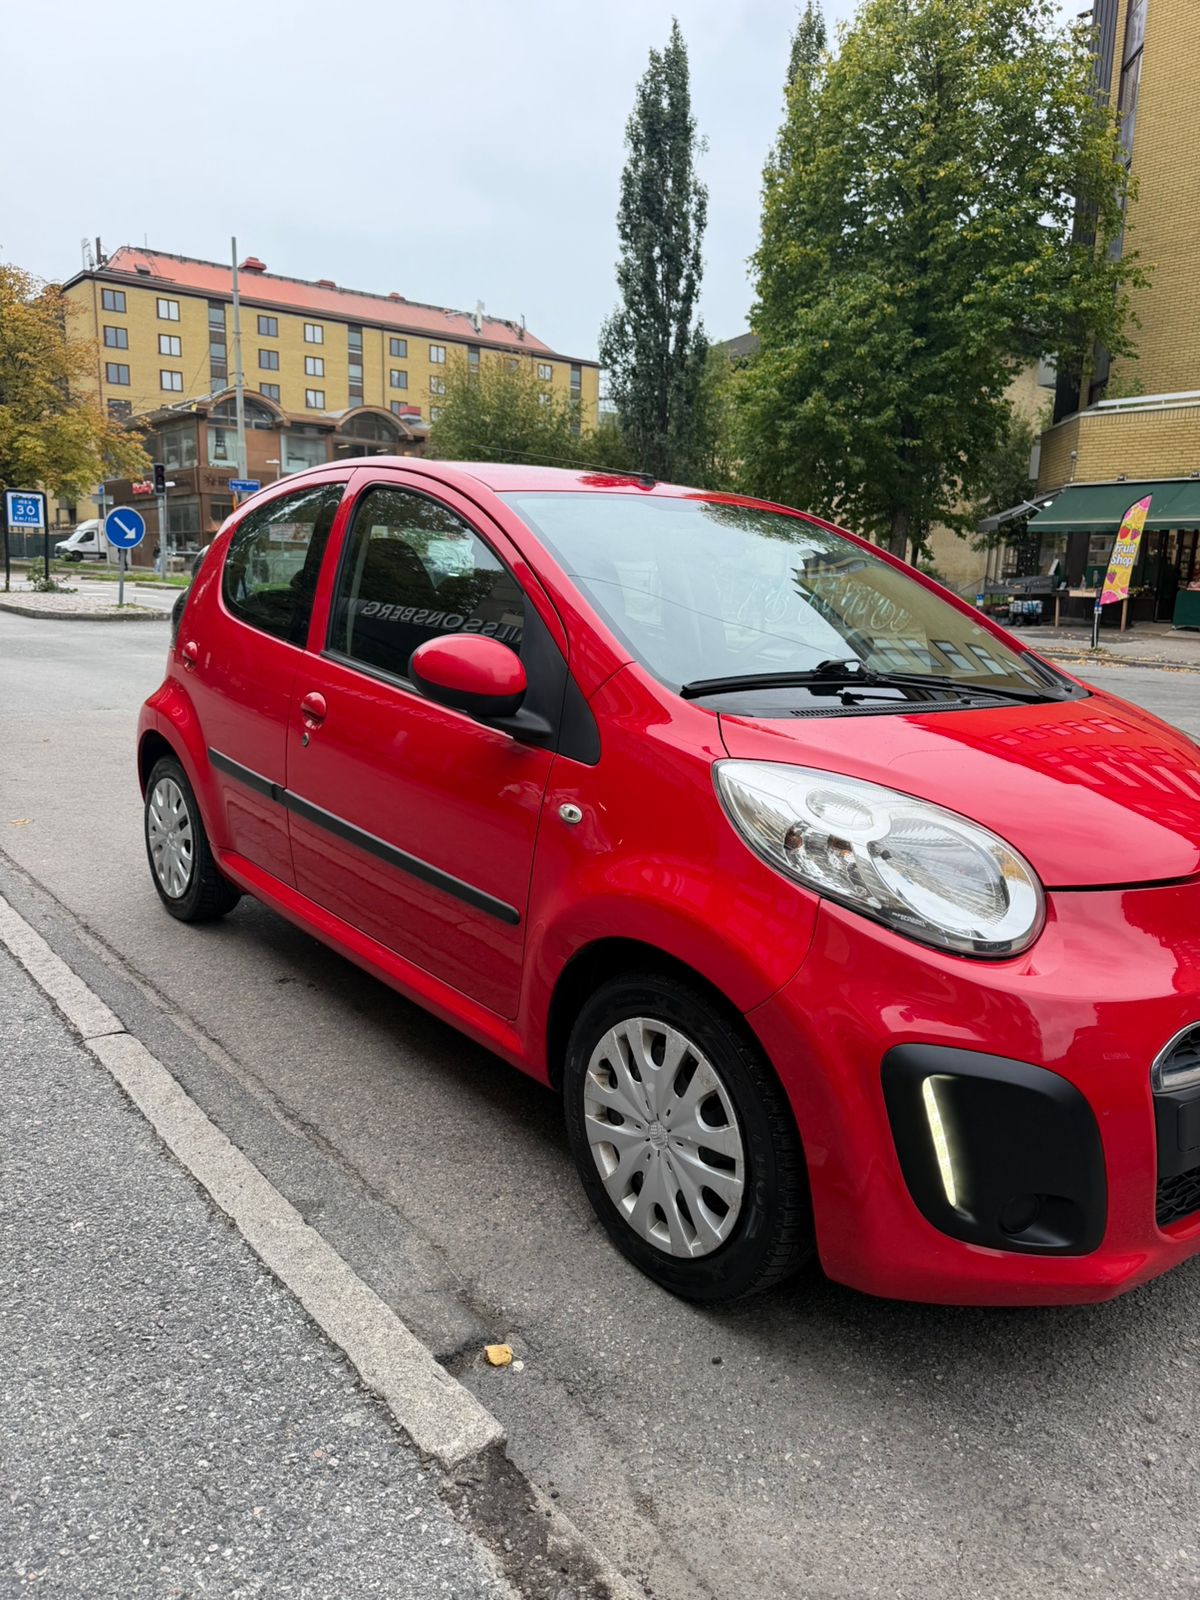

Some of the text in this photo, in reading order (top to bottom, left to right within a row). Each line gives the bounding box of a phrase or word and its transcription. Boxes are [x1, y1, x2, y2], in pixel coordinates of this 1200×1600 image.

[16, 505, 35, 515] 30
[1113, 541, 1136, 554] Fruit
[1110, 554, 1133, 567] Shop
